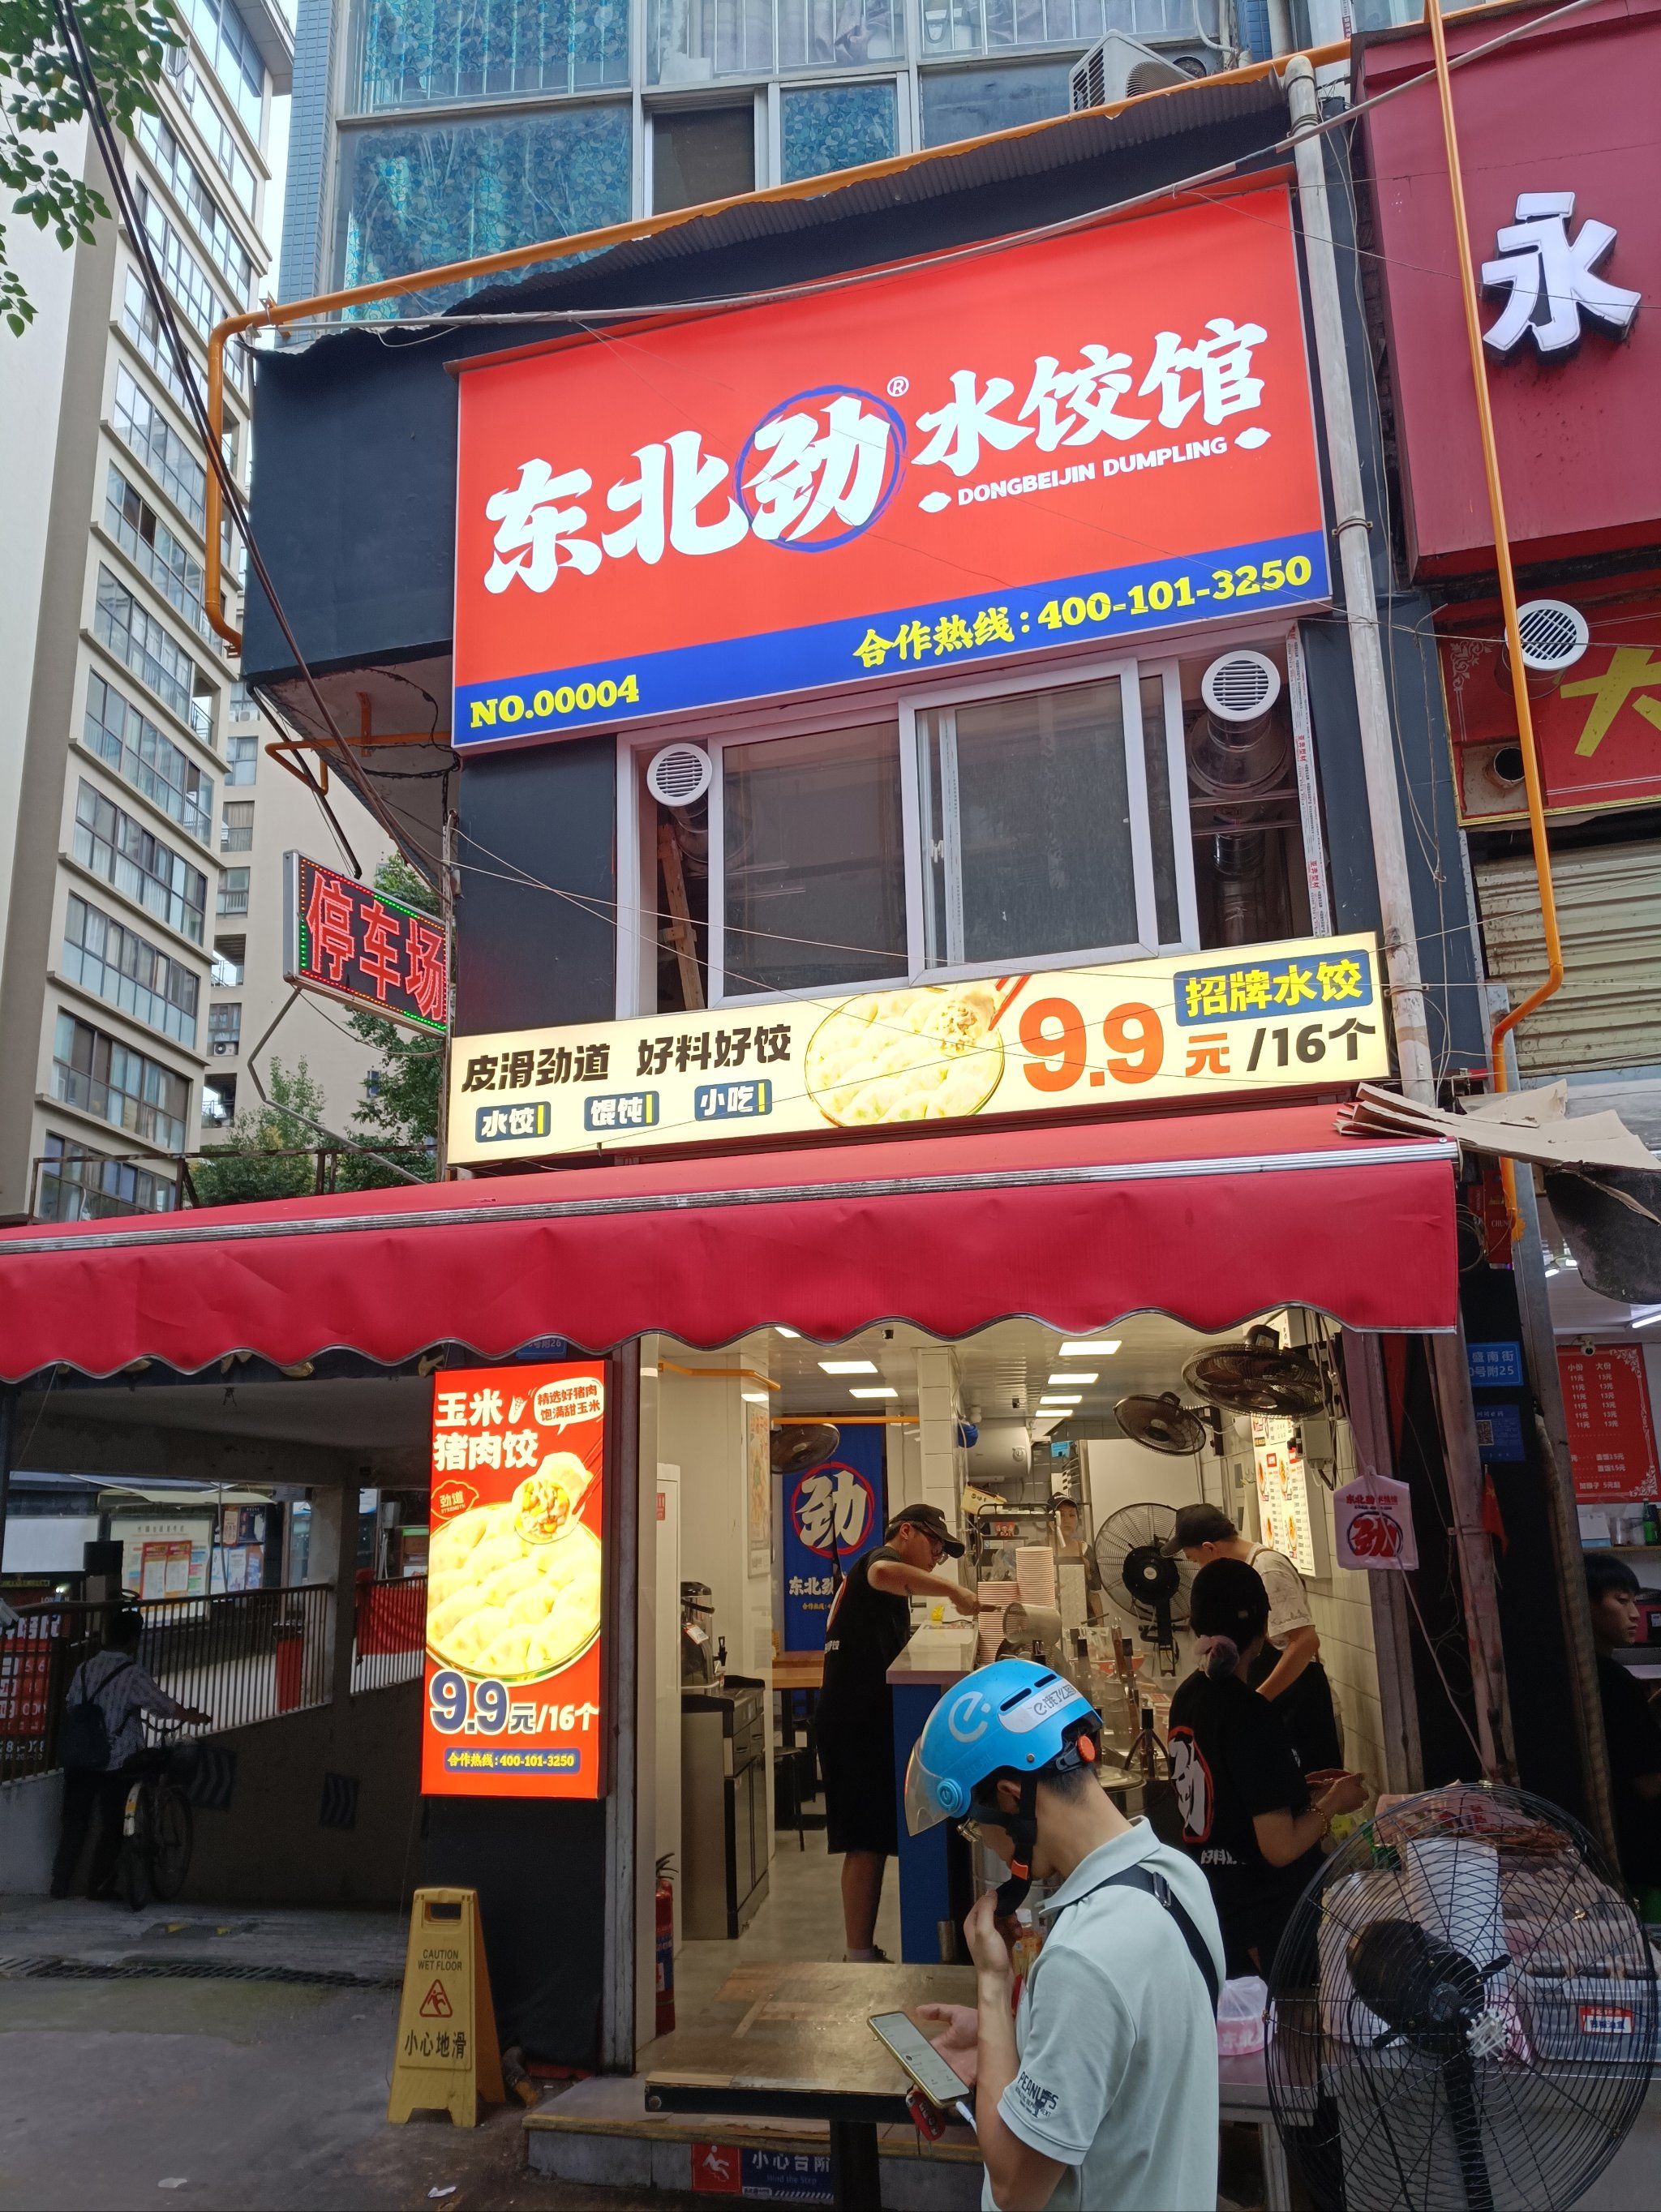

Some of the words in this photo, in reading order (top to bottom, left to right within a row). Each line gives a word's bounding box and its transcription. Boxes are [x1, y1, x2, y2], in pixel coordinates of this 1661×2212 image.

[1481, 191, 1642, 352] 永
[958, 462, 1095, 506] DONGBEIJIN
[1104, 436, 1227, 477] DUMPLING
[470, 675, 639, 727] NO.00004
[307, 872, 446, 1019] 停车场
[1186, 959, 1362, 1018] 招牌水饺
[461, 1044, 610, 1093] 皮滑劲道
[637, 1025, 792, 1077] 好料好饺
[590, 1096, 643, 1127] 馄饨
[700, 1087, 754, 1116] 小吃
[481, 1102, 535, 1138] 水饺
[1470, 1350, 1514, 1363] 盛南街
[435, 1388, 504, 1427] 玉米
[537, 1384, 598, 1406] 精选好猪肉
[540, 1399, 601, 1421] 饱满甜玉米
[433, 1429, 539, 1472] 猪肉饺
[439, 1490, 465, 1507] 劲道
[796, 1470, 867, 1548] 劲
[418, 1960, 435, 1971] WET
[436, 1960, 462, 1971] FLOOR
[423, 1949, 458, 1960] CAUTION
[405, 2030, 467, 2059] 小心地滑
